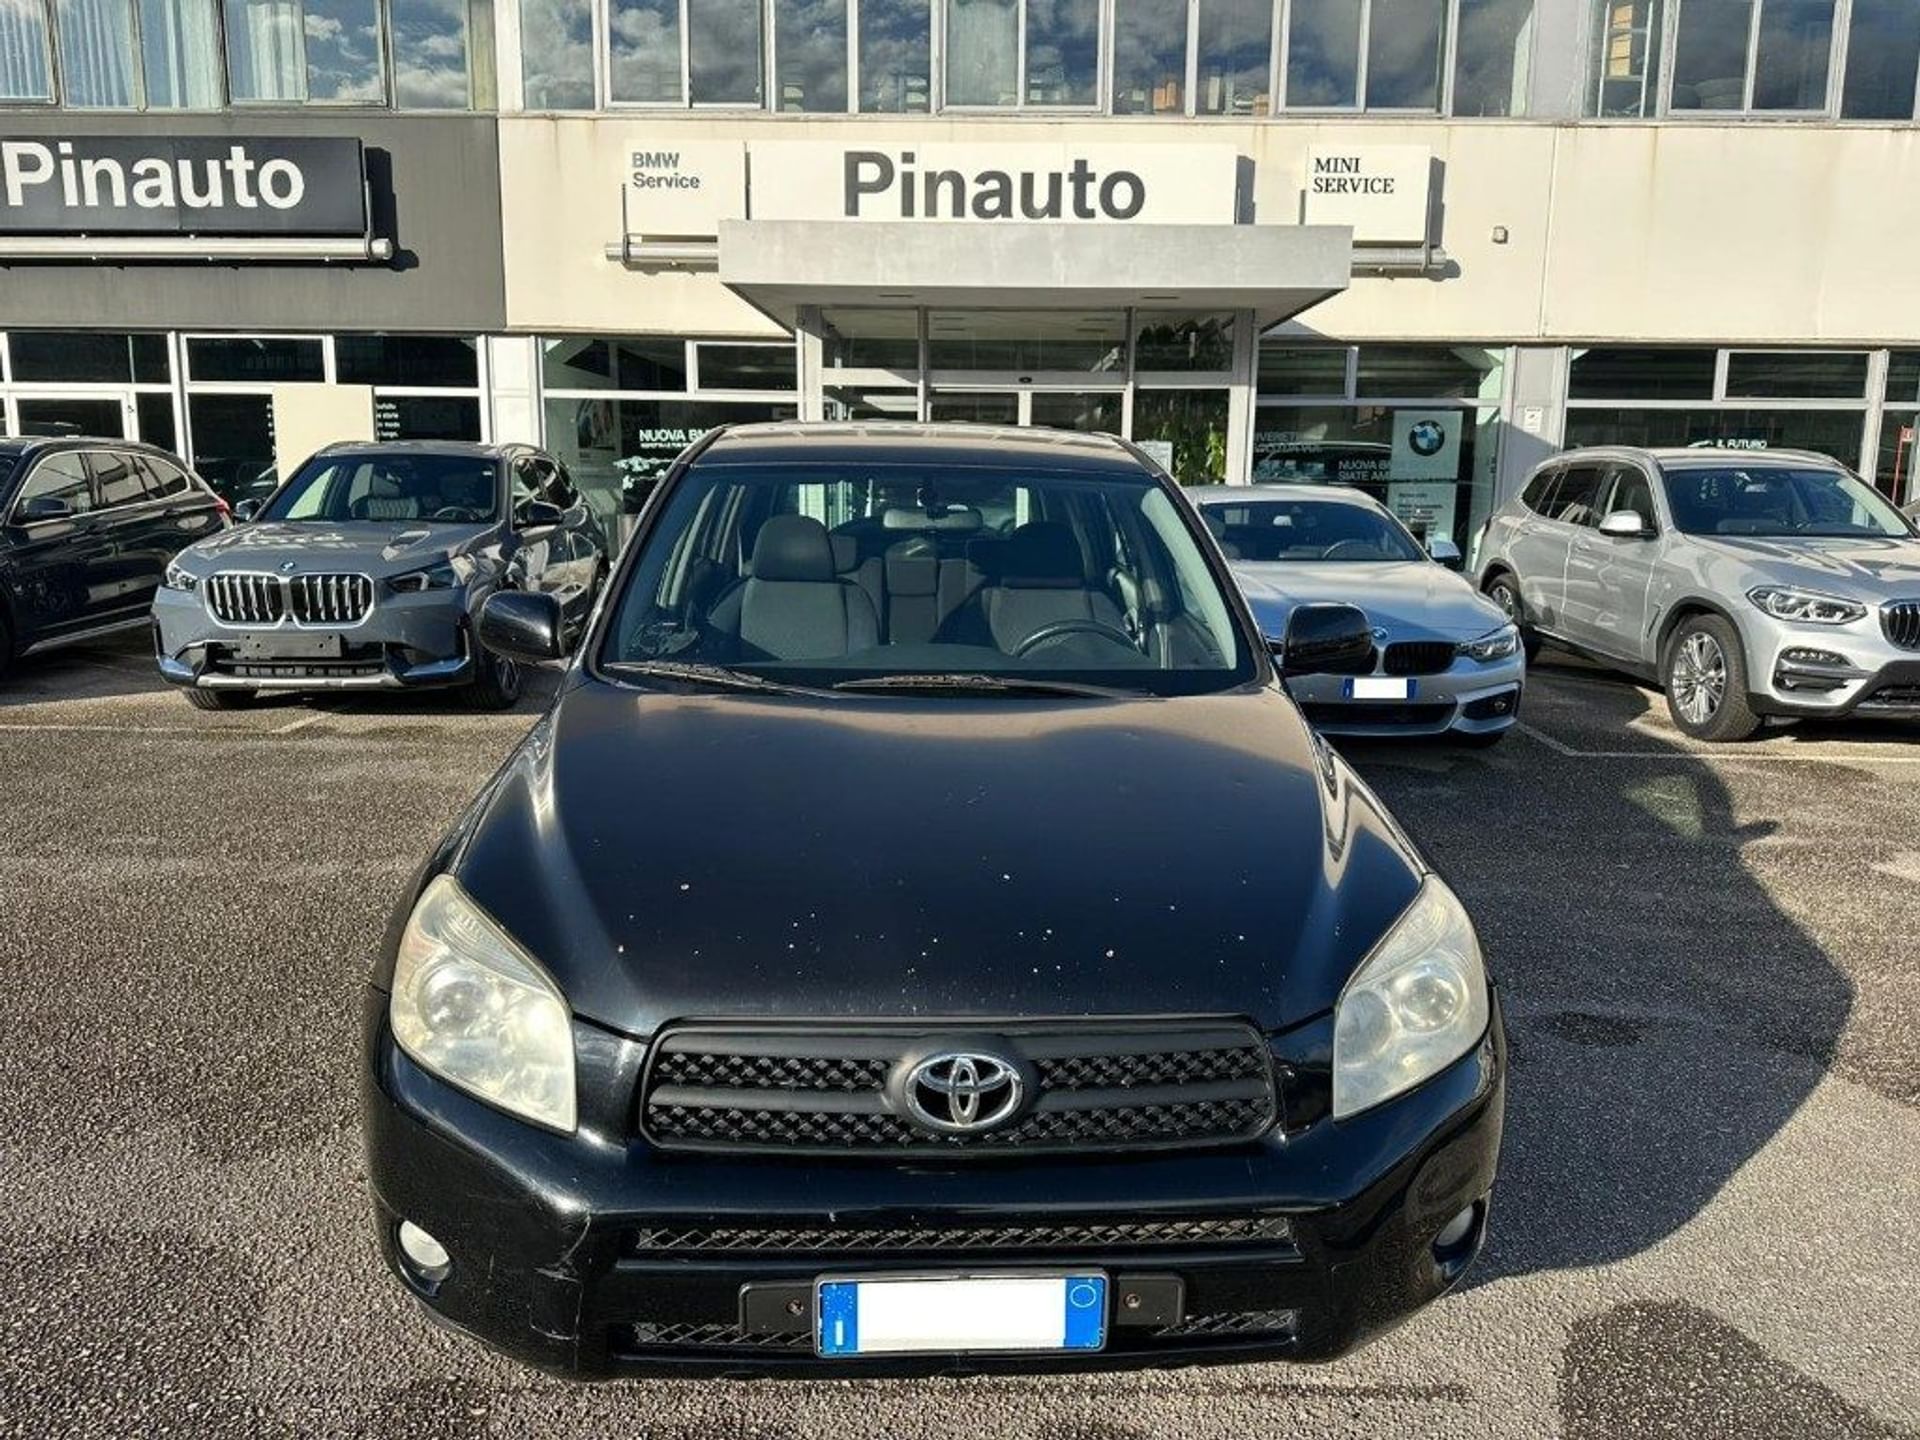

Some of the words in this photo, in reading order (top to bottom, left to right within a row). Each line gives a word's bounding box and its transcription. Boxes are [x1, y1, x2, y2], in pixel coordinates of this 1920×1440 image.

[632, 152, 680, 168] BMW
[1314, 157, 1361, 173] MINI
[2, 141, 305, 209] Pinauto
[633, 172, 701, 188] Service
[844, 151, 1146, 219] Pinauto
[1312, 177, 1394, 193] SERVICE
[639, 429, 686, 442] NUOVA
